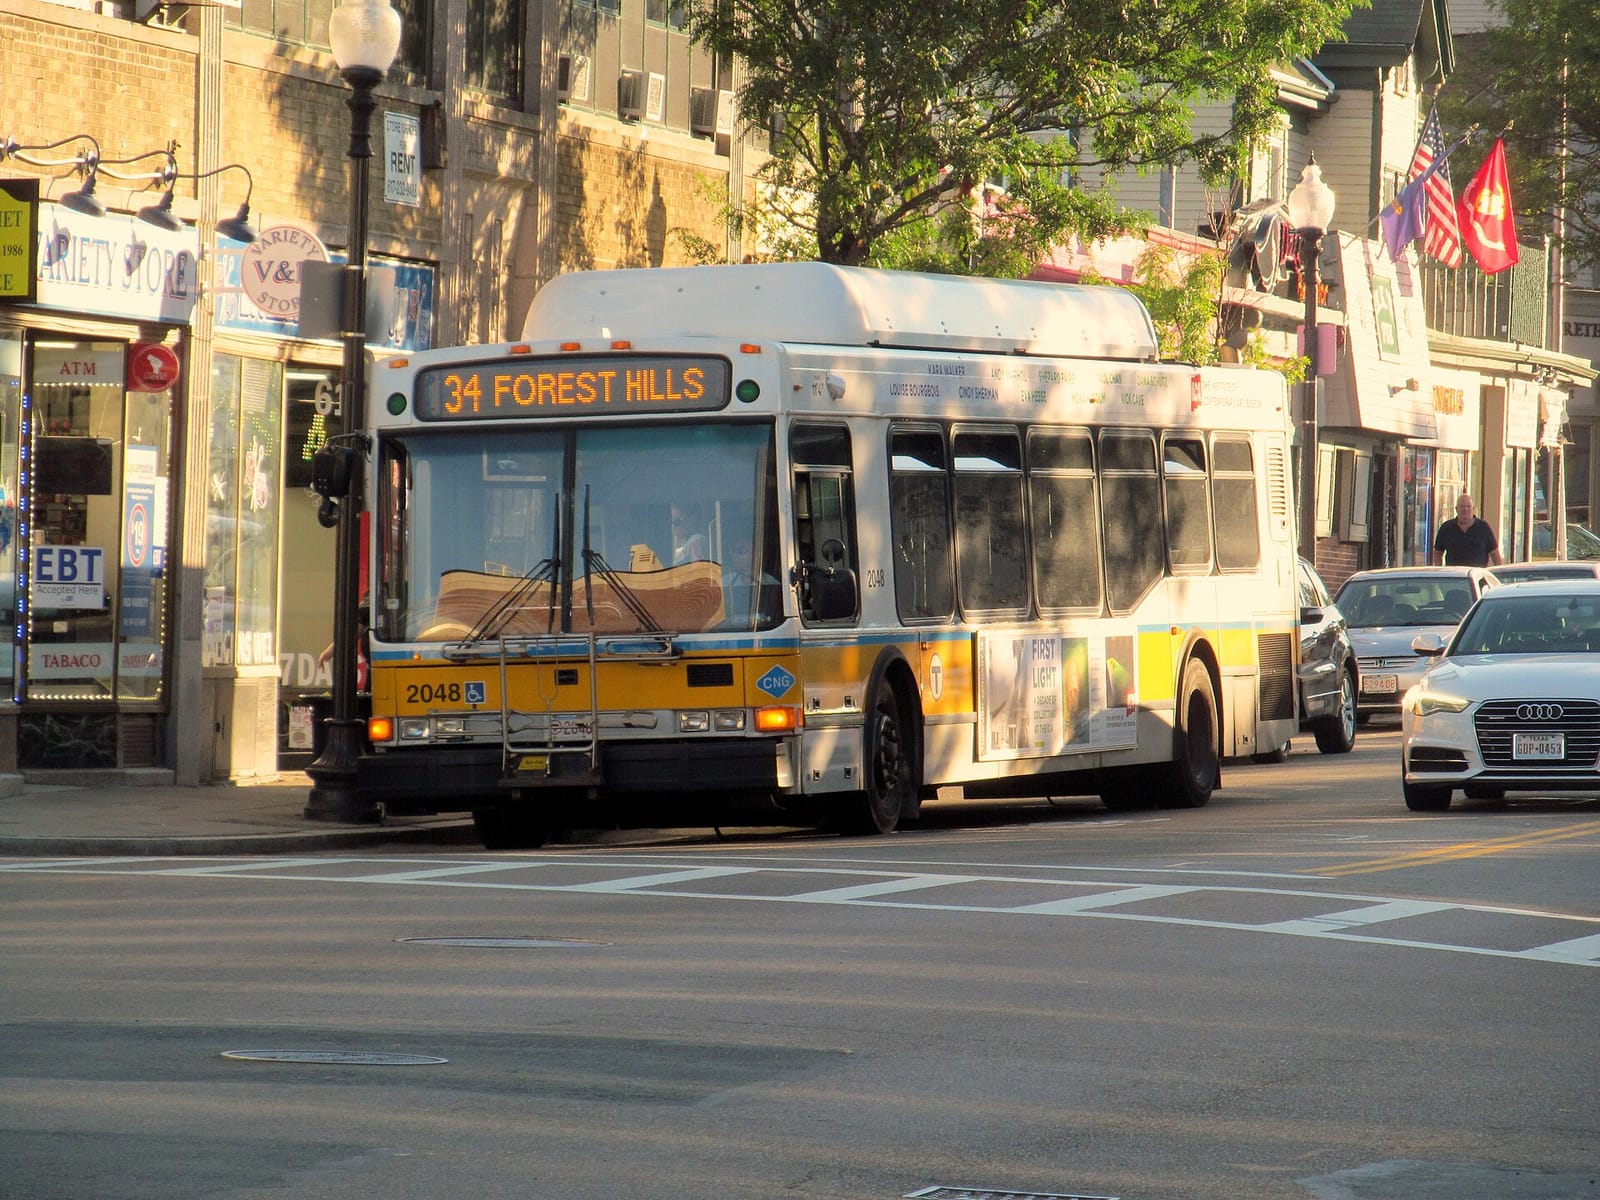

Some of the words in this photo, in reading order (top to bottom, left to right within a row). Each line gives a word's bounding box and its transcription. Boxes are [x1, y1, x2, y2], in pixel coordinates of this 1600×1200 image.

[390, 151, 416, 175] RENT
[2, 244, 24, 258] 1986
[251, 229, 320, 256] VARIETY
[122, 243, 188, 299] STORE
[253, 260, 302, 284] V&
[257, 291, 300, 313] STOR
[60, 362, 97, 376] ATM
[943, 364, 966, 377] WALKER
[444, 373, 482, 414] 34
[494, 370, 617, 407] FOREST
[625, 367, 705, 402] HILLS
[889, 383, 909, 397] LOUISE
[36, 548, 102, 582] EBT
[867, 569, 885, 588] 2048
[37, 585, 76, 596] Accepted
[79, 586, 98, 595] Here
[1032, 638, 1056, 660] FIRST
[42, 653, 101, 668] TABACO
[763, 675, 790, 690] CNG
[1032, 666, 1057, 689] LIGHT
[406, 683, 461, 704] 2048
